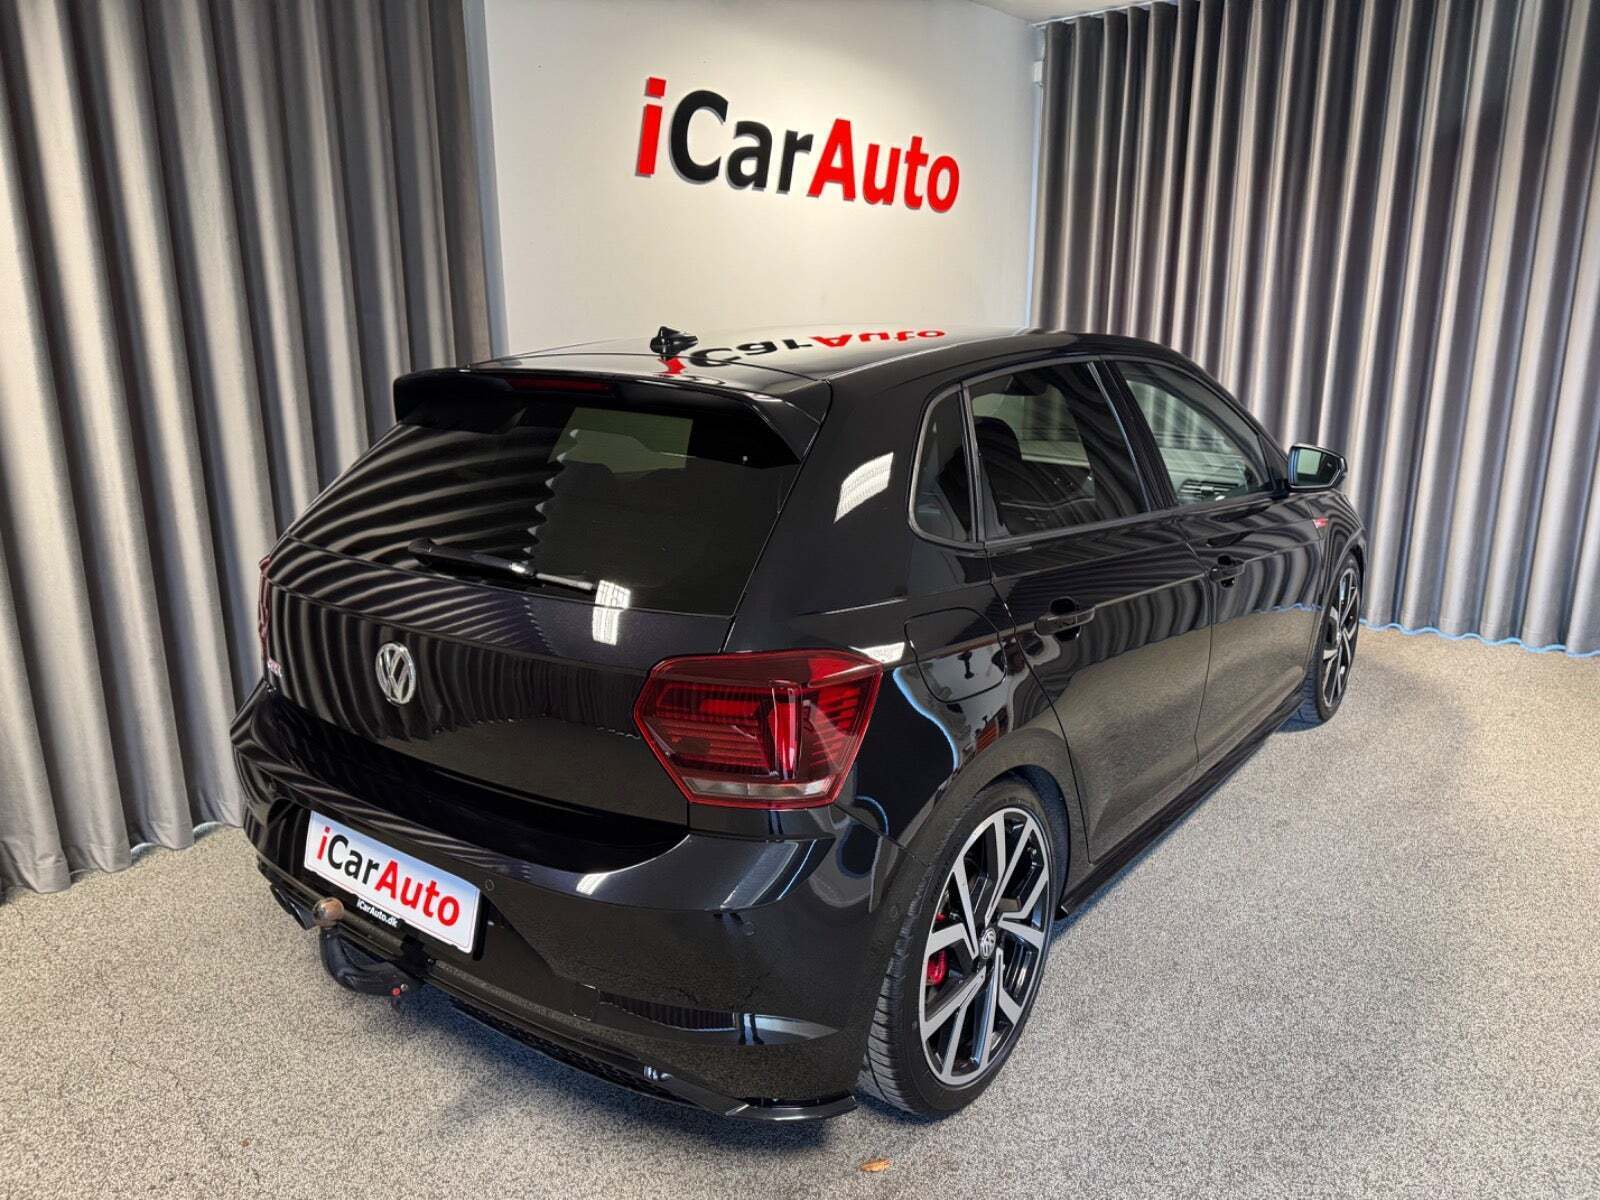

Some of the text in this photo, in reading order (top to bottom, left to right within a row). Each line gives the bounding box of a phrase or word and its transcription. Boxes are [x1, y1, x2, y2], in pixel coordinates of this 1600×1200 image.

[636, 77, 960, 213] iCarAuto
[316, 826, 460, 926] iCarAuto
[356, 898, 399, 928] iCarAuto.dk
